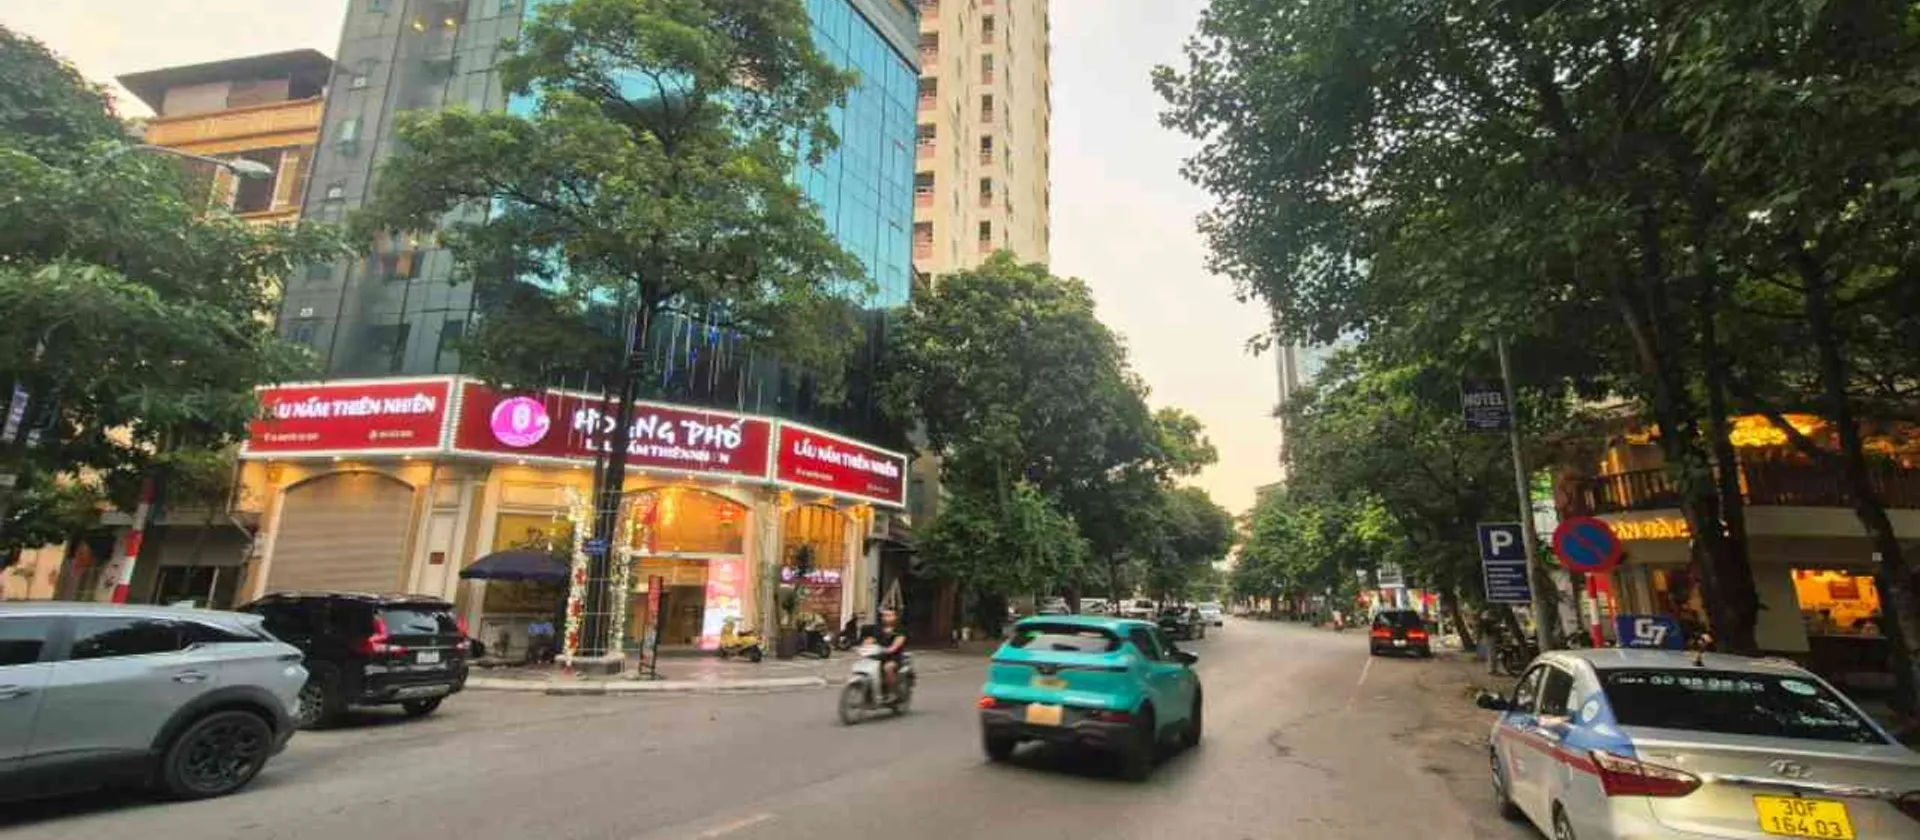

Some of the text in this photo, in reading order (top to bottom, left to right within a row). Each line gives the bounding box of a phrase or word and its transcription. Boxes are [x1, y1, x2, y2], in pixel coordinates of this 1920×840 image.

[333, 396, 380, 416] THIÊN
[383, 393, 436, 414] NHIÊN
[1464, 391, 1504, 407] HOTEL
[1489, 529, 1514, 556] P
[1634, 618, 1667, 645] G7
[1780, 799, 1817, 818] 30F
[1770, 815, 1842, 837] 164.03
